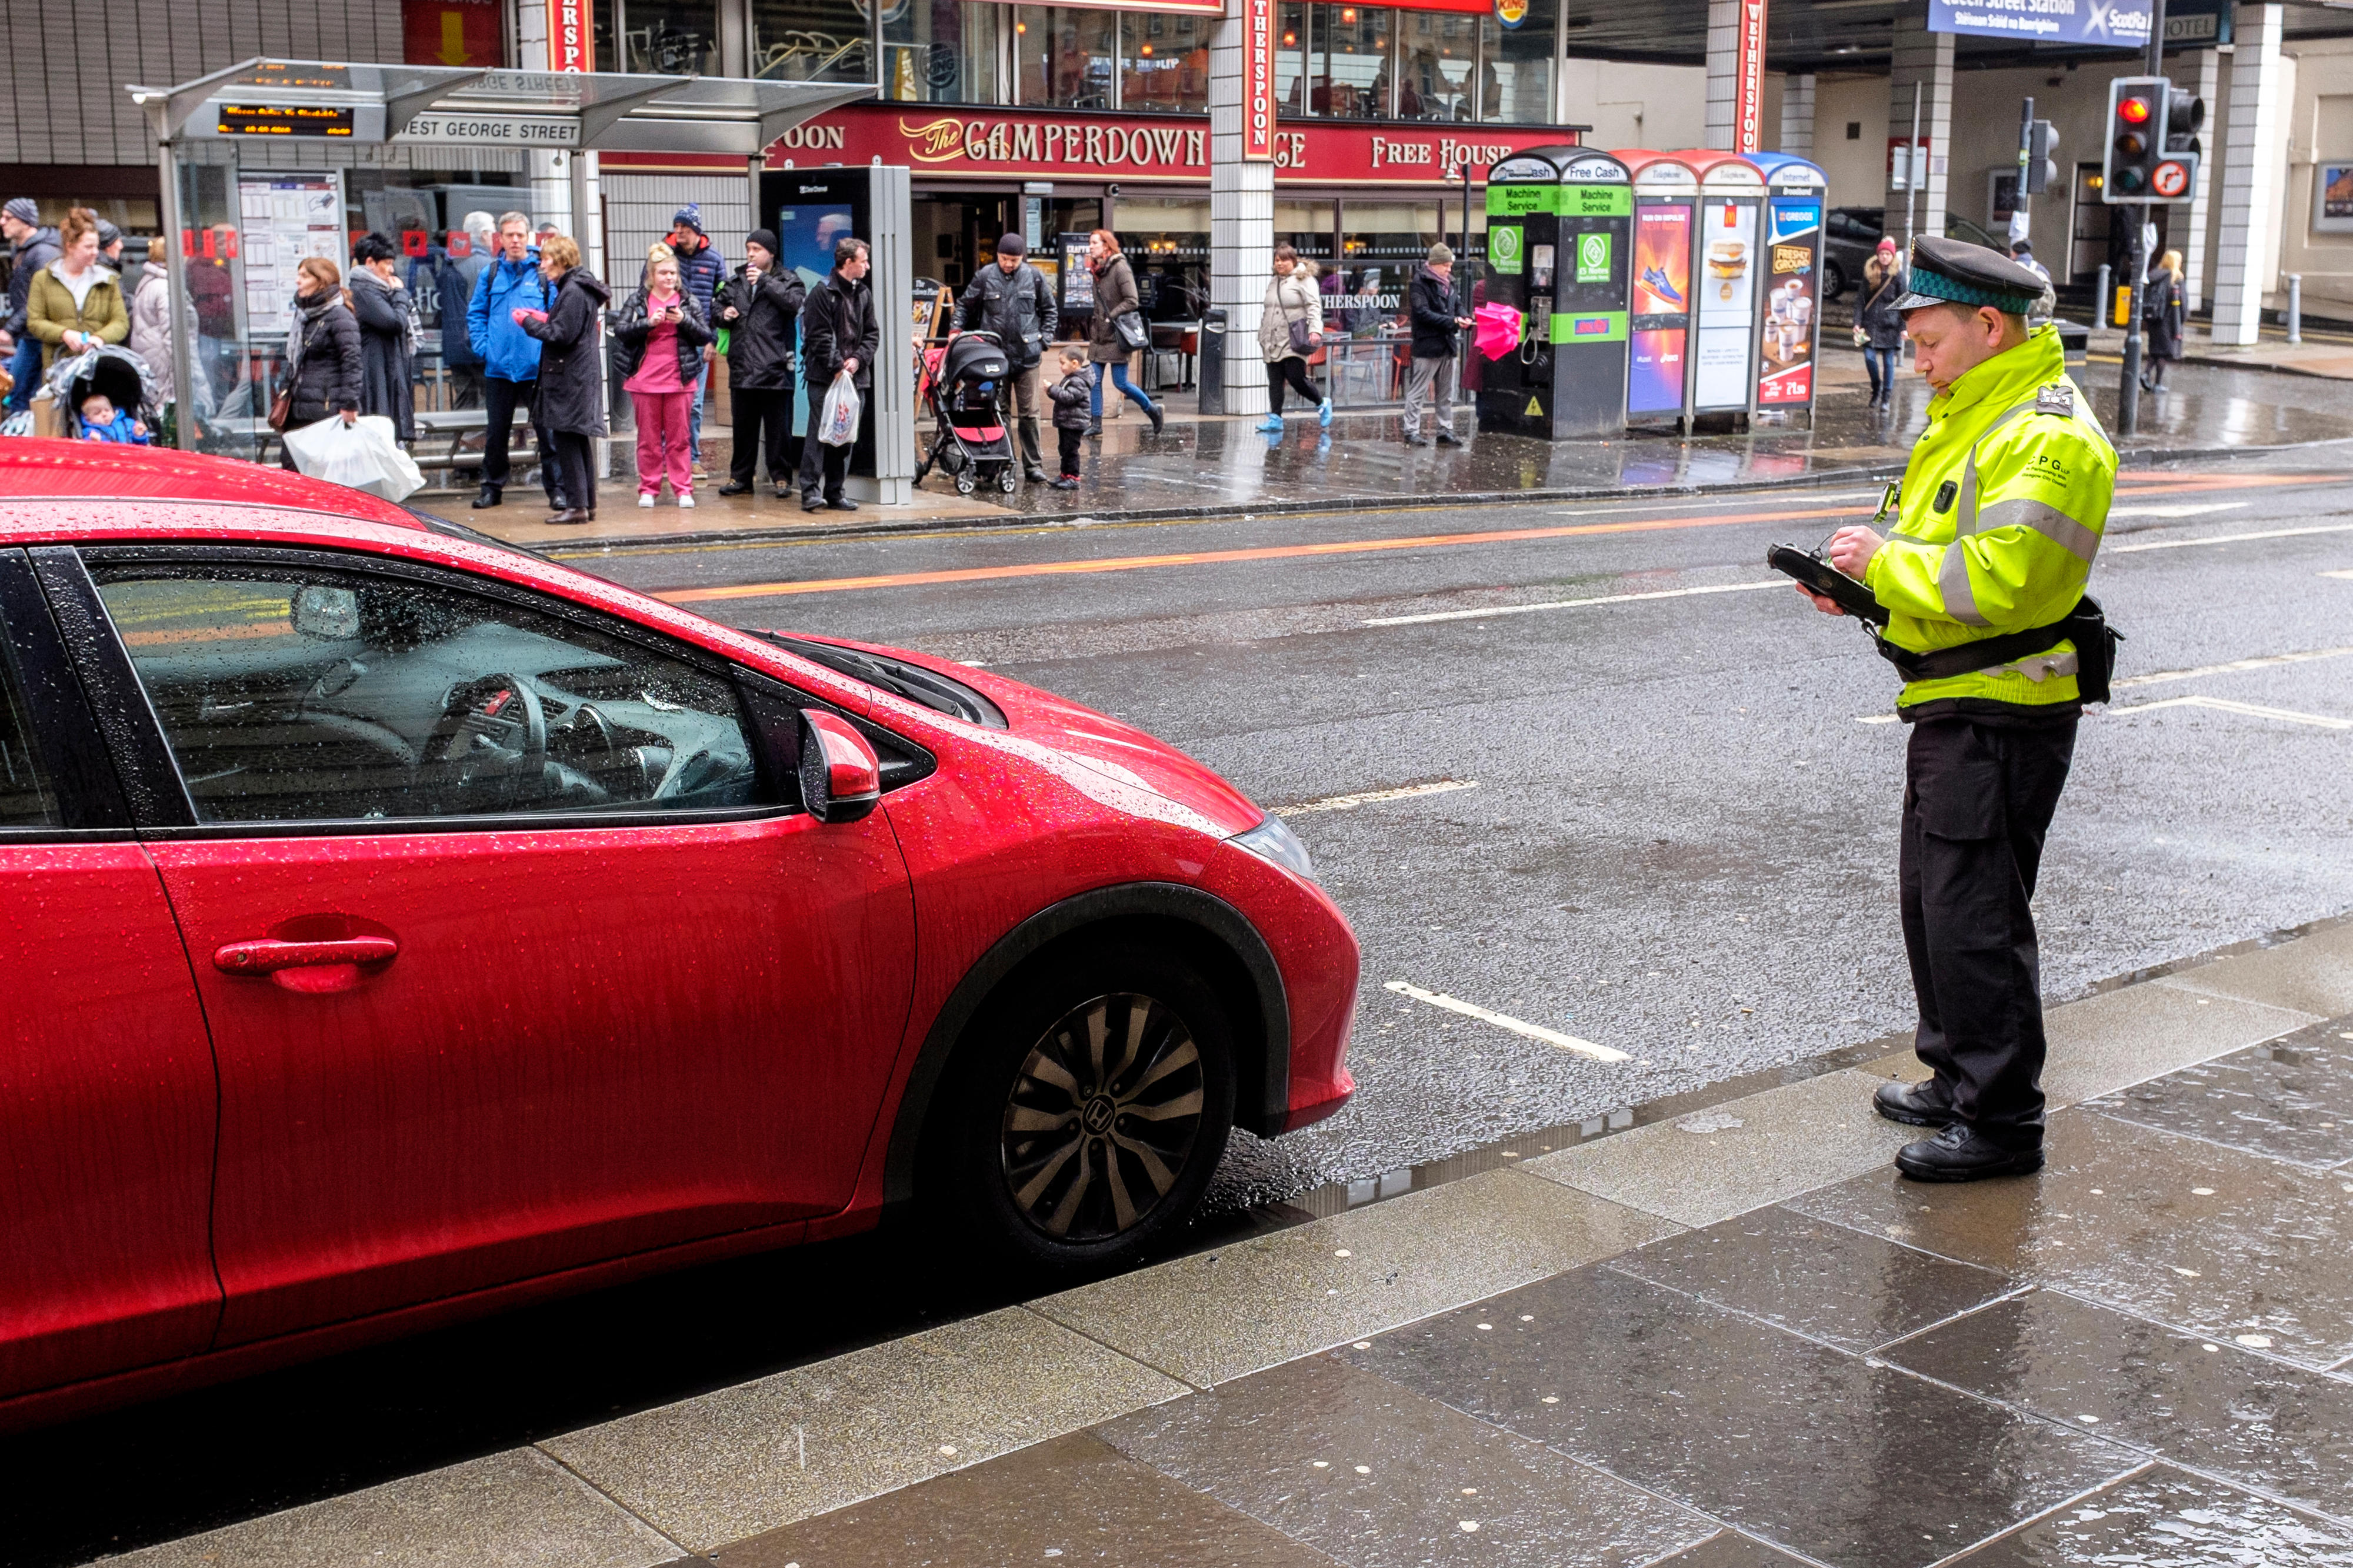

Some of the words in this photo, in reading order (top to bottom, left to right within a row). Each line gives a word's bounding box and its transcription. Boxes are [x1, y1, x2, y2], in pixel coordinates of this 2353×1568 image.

[2165, 18, 2211, 36] OTEL
[1254, 0, 1267, 145] THERSPOON
[446, 122, 511, 137] GEORGE
[519, 124, 576, 140] STREET
[766, 125, 845, 149] OON
[925, 125, 961, 155] The
[965, 122, 1206, 166] CAMPERDOWN
[1570, 166, 1592, 178] Free
[1595, 166, 1619, 178] Cash
[1506, 189, 1541, 199] Machine
[1580, 189, 1614, 199] Machine
[1507, 201, 1538, 211] Service
[1581, 202, 1611, 212] Service
